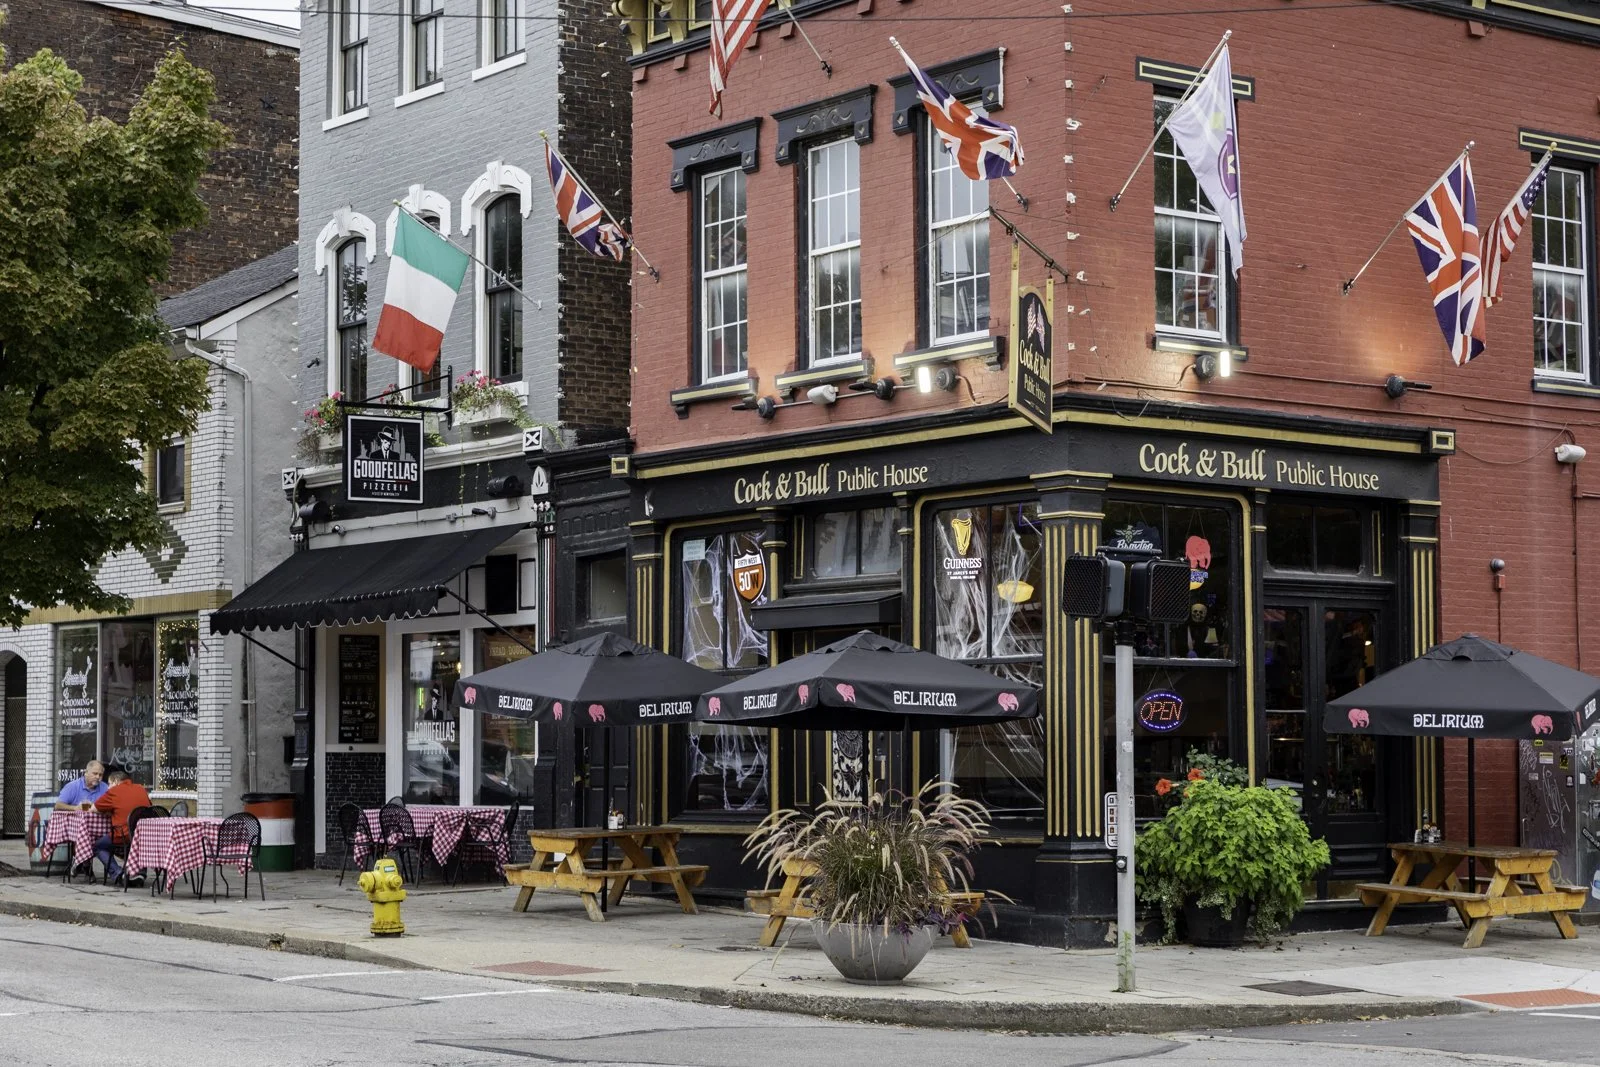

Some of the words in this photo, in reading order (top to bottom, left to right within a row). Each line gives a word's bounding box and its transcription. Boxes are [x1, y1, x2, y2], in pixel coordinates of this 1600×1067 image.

[1019, 339, 1034, 371] Cock
[1033, 351, 1039, 376] &
[1039, 354, 1051, 385] Bull
[1024, 373, 1036, 396] Public
[1035, 381, 1046, 404] House
[353, 459, 418, 482] GOODFELLAS
[1139, 442, 1192, 476] Cock
[1195, 448, 1217, 478] &
[1220, 448, 1267, 481] Bull
[1275, 460, 1326, 486] Public
[1329, 464, 1379, 490] House
[363, 482, 408, 492] PIZZERIA
[734, 470, 773, 504] Cock
[775, 472, 792, 500] &
[794, 463, 830, 498] Bull
[837, 465, 879, 492] Public
[883, 464, 928, 487] House
[737, 559, 748, 567] FIFTY
[748, 557, 758, 565] WEST
[943, 557, 982, 569] GUINNESS
[62, 698, 90, 707] GROOMING
[163, 701, 194, 711] NUTRITN
[498, 695, 533, 711] DELIRIUM
[743, 693, 778, 710] DELIRIUM
[893, 690, 957, 707] DELIRIUM
[62, 707, 90, 717] NUTRITION
[640, 701, 693, 718] DELIRIUM
[1140, 701, 1183, 721] OPEN
[1412, 714, 1484, 729] DELIRIUM
[414, 721, 455, 742] GOODFELLAS
